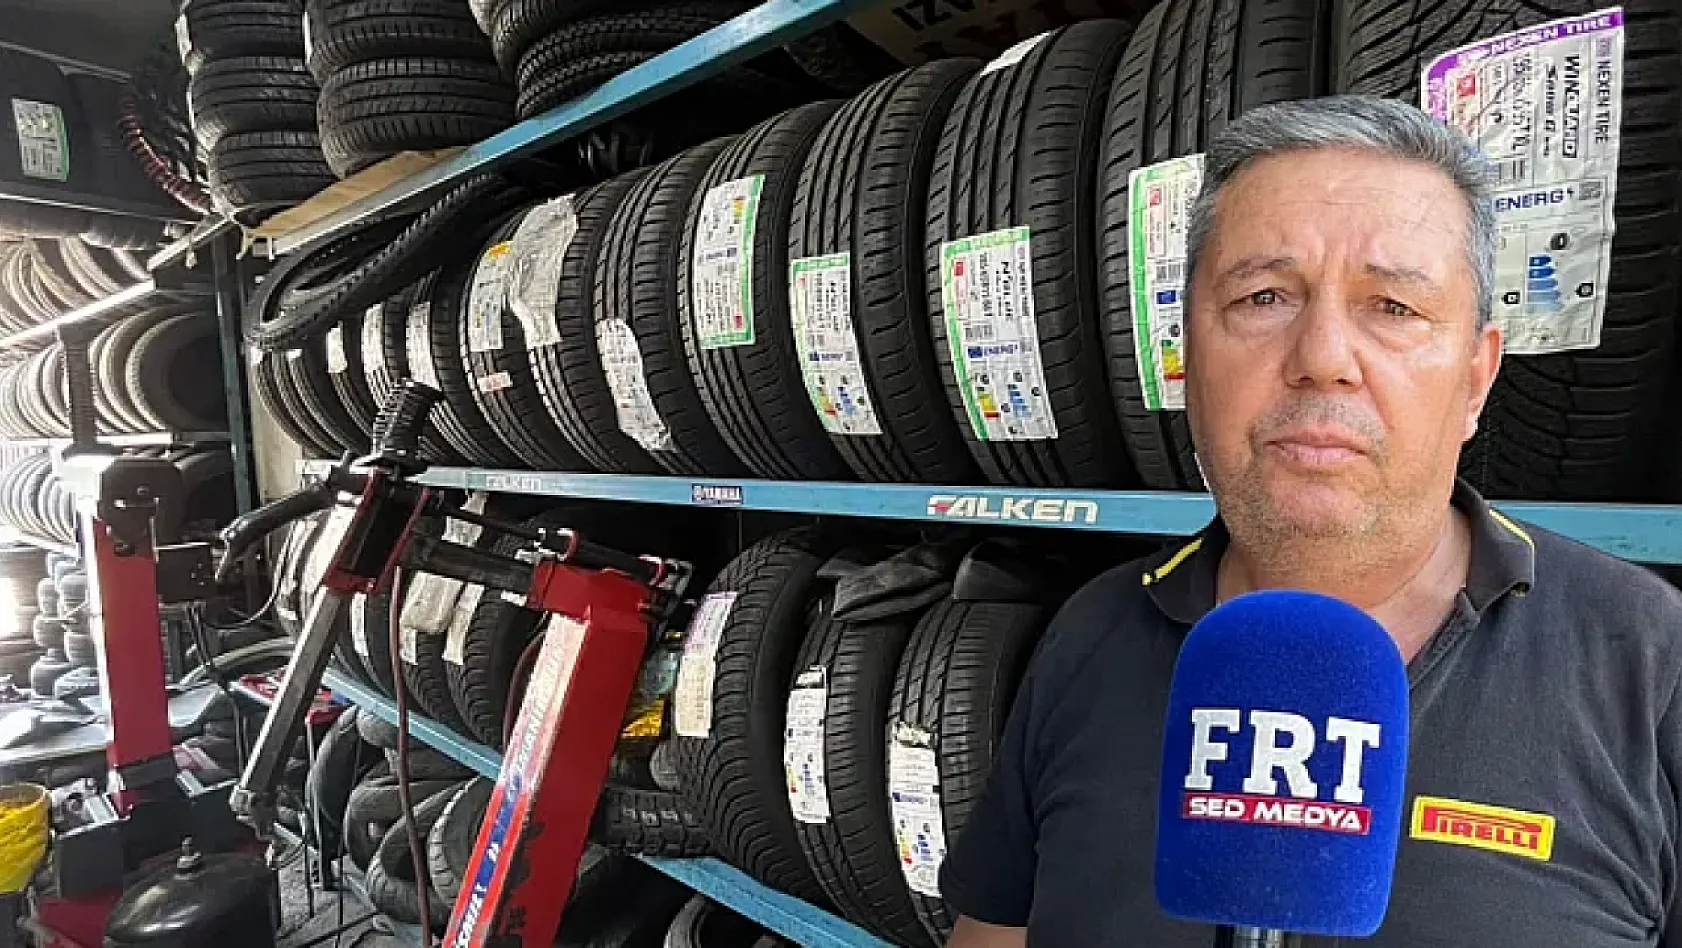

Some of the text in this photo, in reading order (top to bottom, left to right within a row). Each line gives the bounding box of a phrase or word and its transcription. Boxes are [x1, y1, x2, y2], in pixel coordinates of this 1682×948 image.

[1595, 61, 1612, 145] NEXEN TIRE
[1495, 188, 1564, 213] ENERG
[927, 493, 1098, 524] FALKEN
[1184, 708, 1380, 804] FRT
[1188, 796, 1362, 832] SED MEDYA
[1423, 805, 1543, 851] PIRELLI
